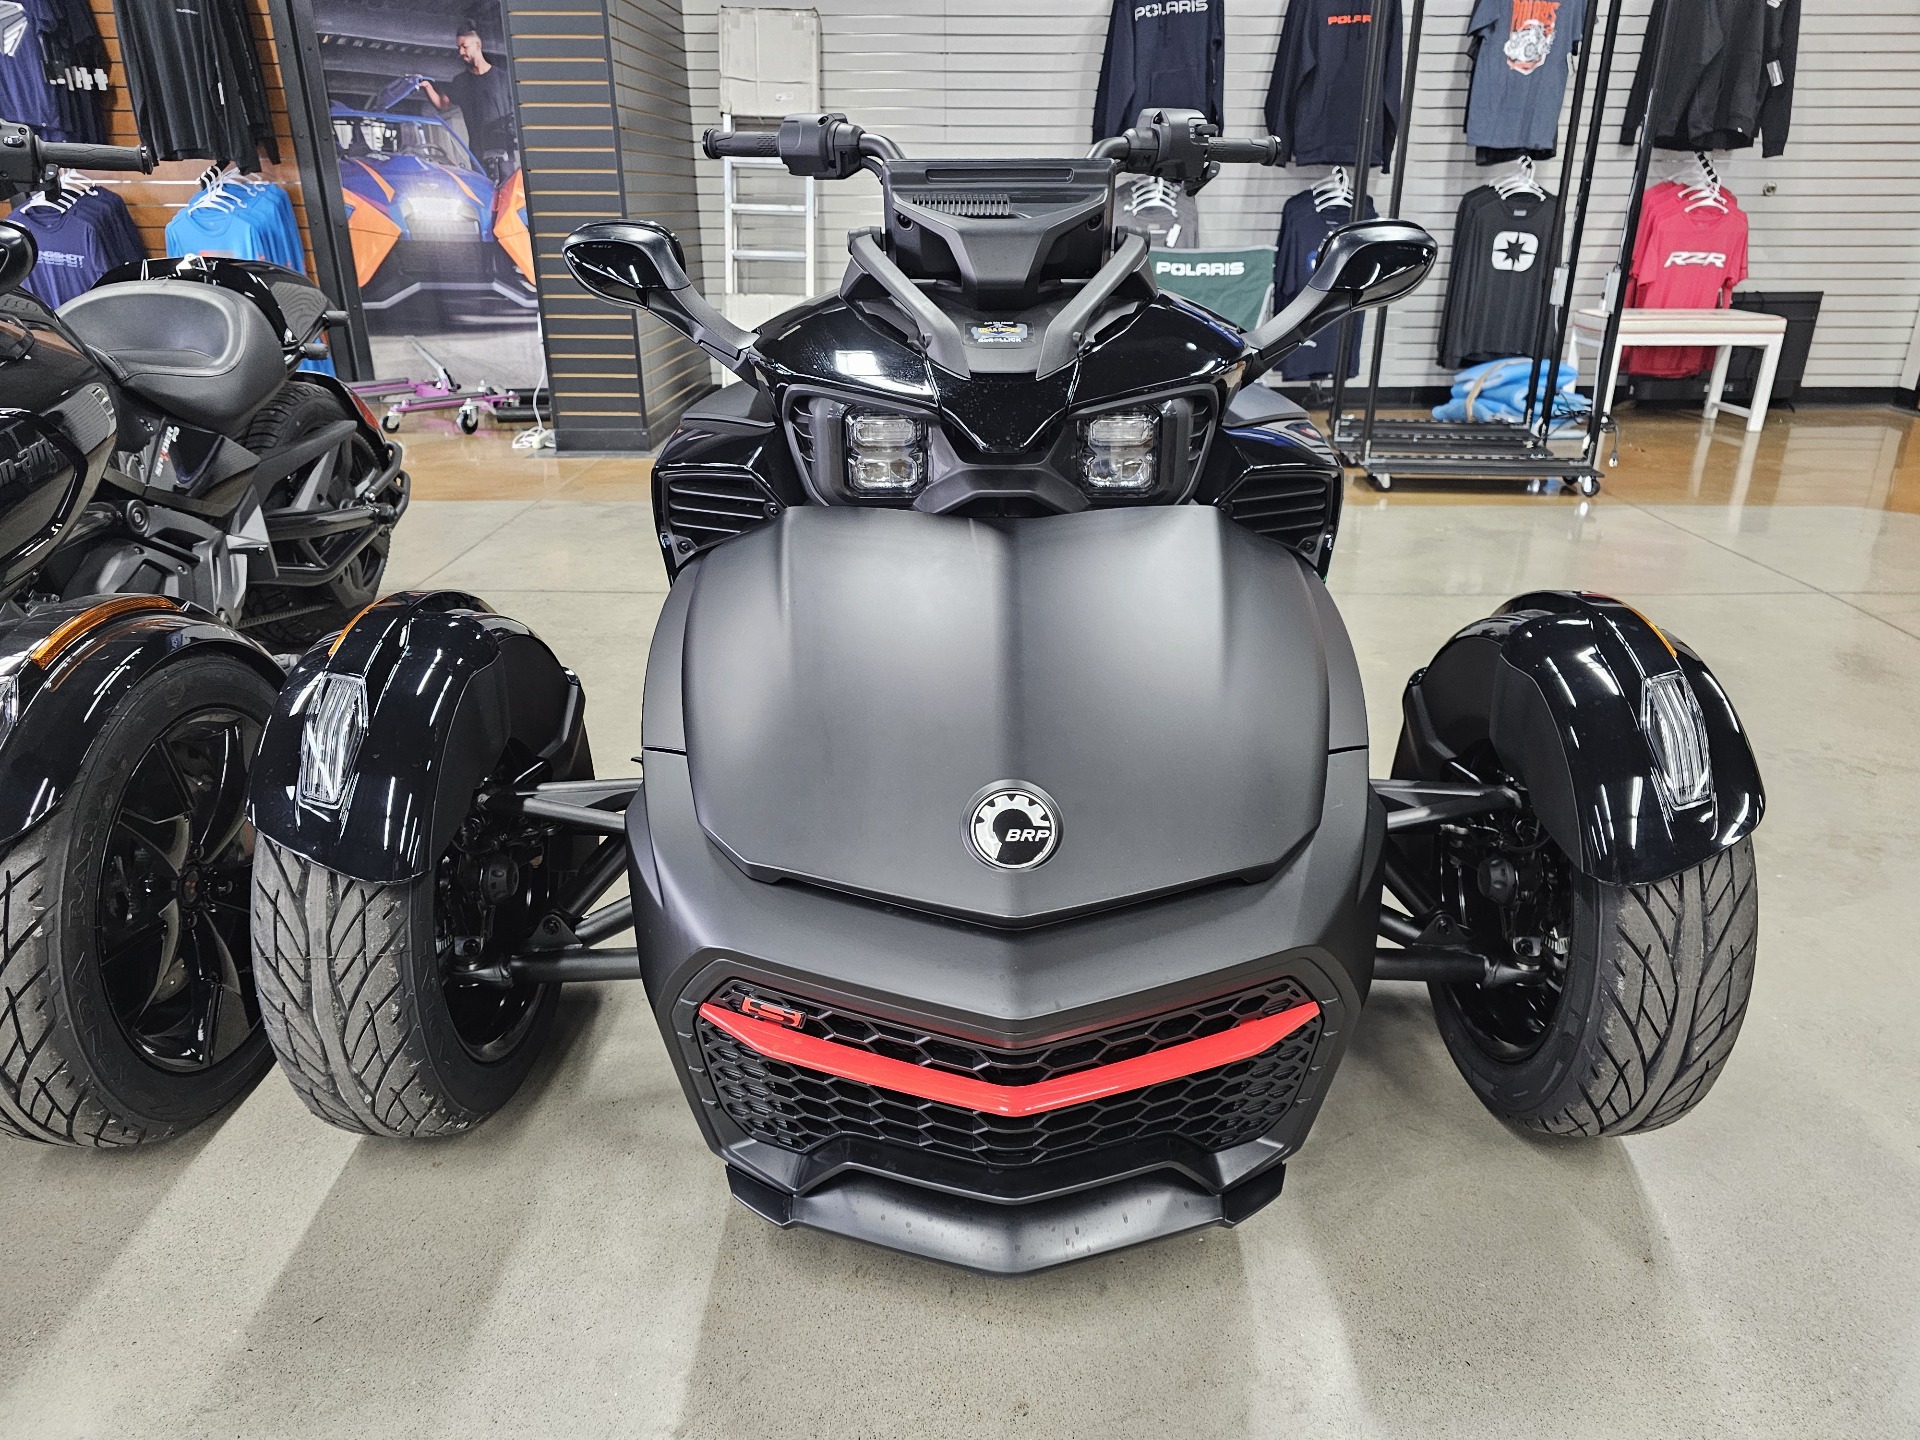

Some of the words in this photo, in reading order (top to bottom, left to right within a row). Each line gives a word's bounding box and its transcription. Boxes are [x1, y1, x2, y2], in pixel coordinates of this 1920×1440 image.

[1134, 0, 1208, 21] POLARIS
[1663, 251, 1726, 268] RZR
[1155, 261, 1245, 276] POLARIS
[1005, 828, 1051, 842] BRP
